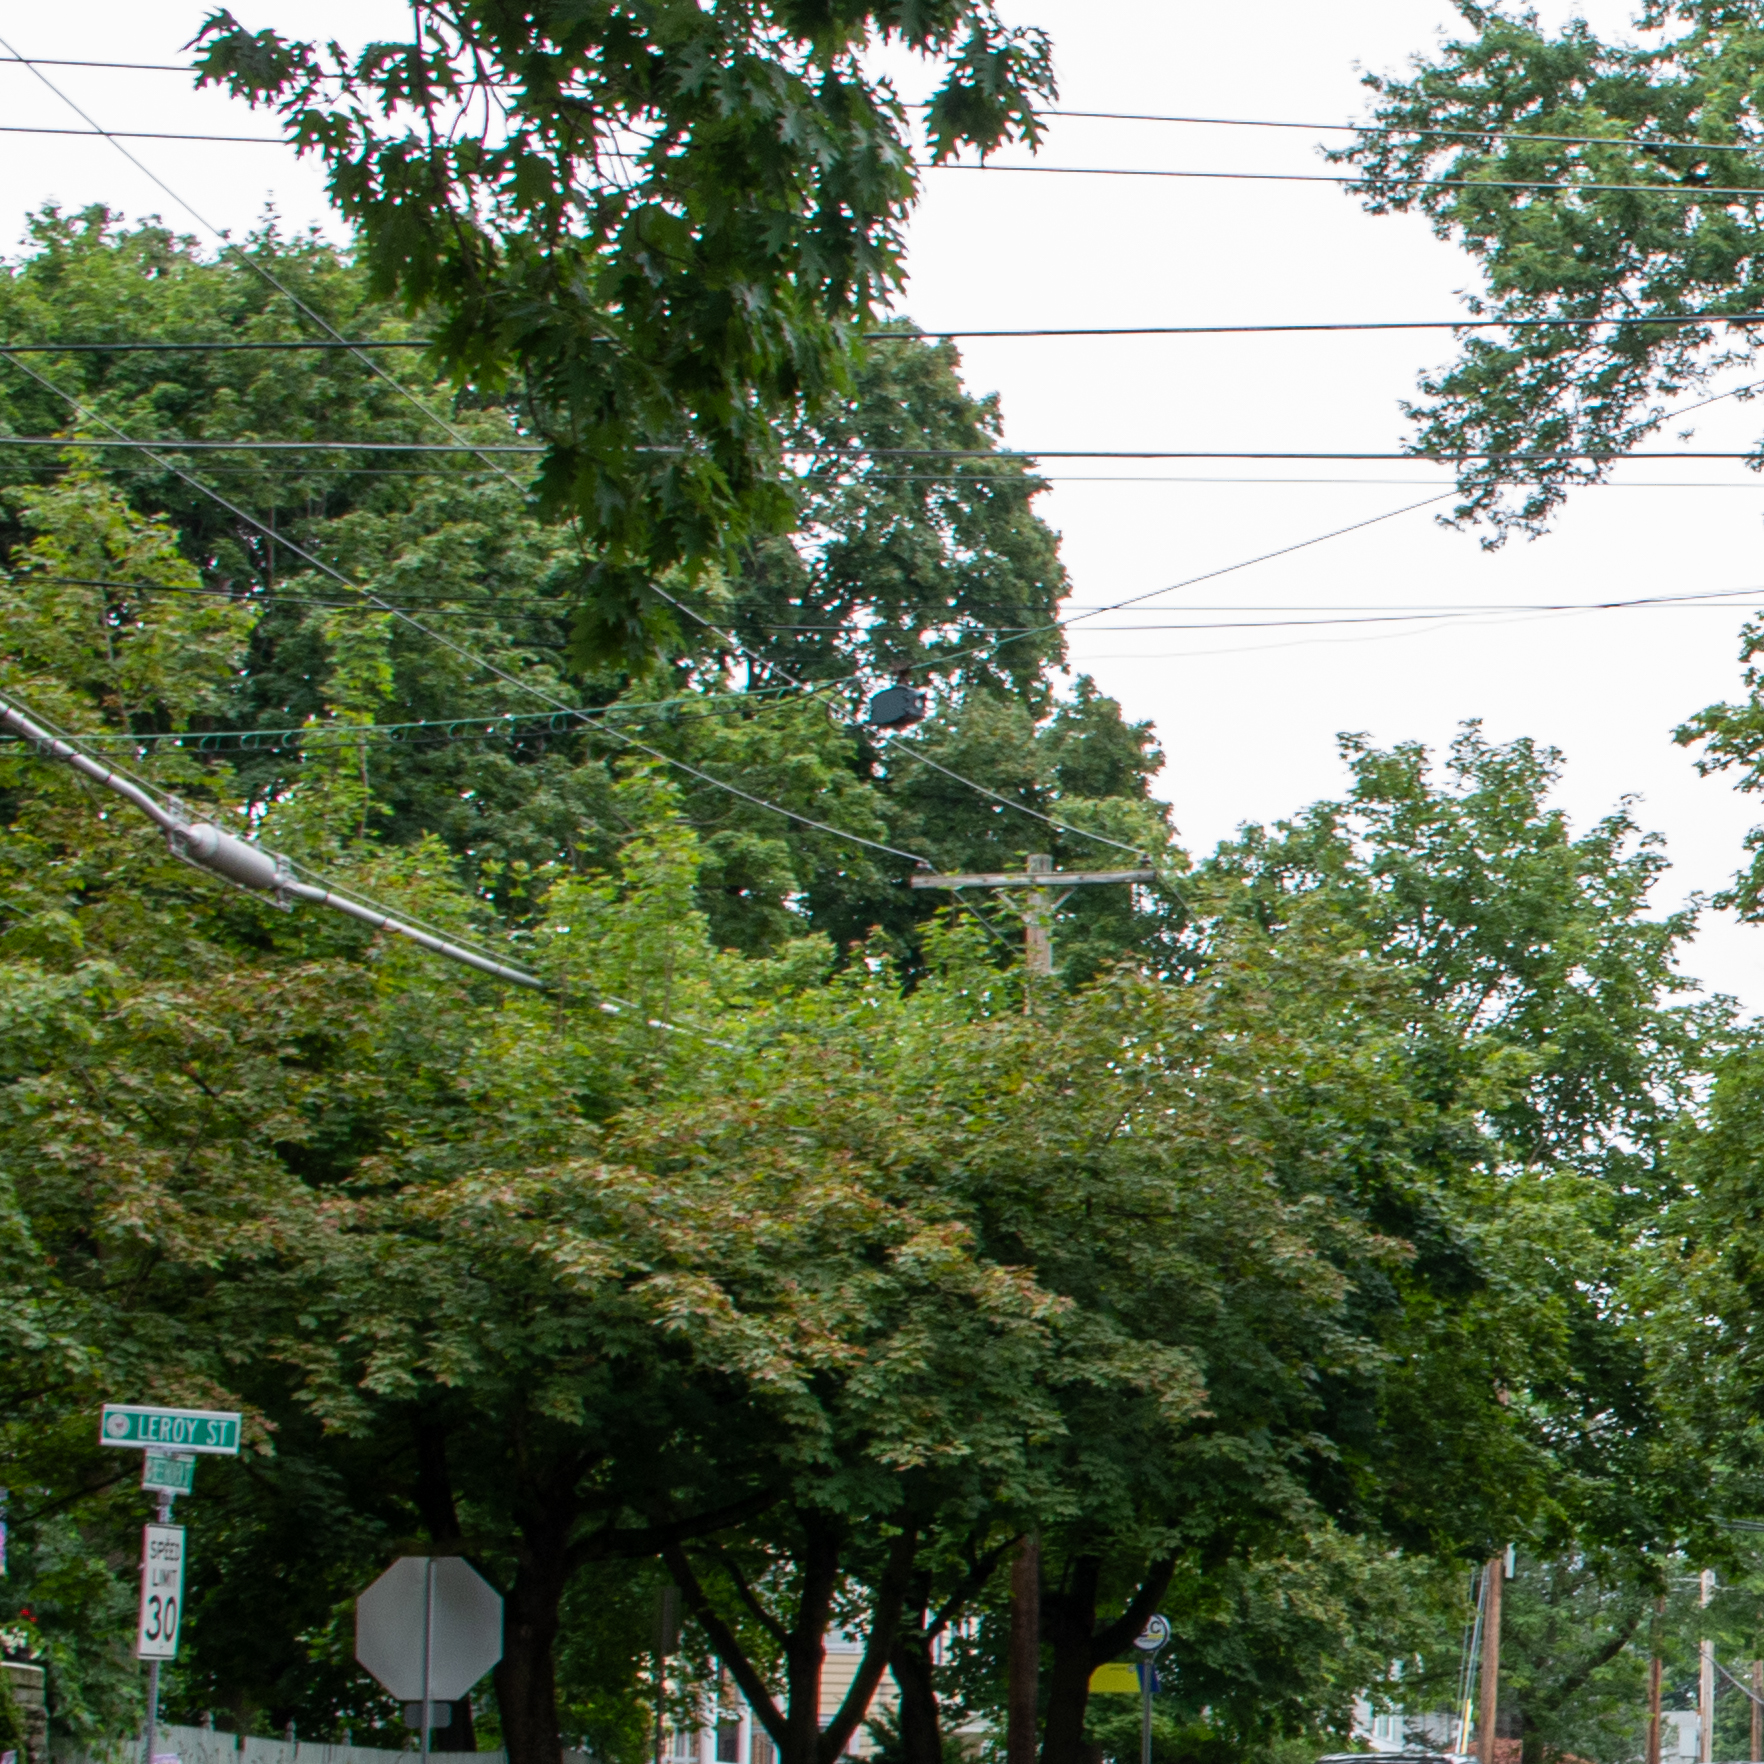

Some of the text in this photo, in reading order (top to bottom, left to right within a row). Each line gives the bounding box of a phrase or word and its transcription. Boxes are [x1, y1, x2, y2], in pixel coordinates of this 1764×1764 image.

[138, 1415, 228, 1445] LEROY ST
[150, 1541, 180, 1561] SPEED
[152, 1568, 177, 1587] LIMIT
[145, 1595, 177, 1642] 30
